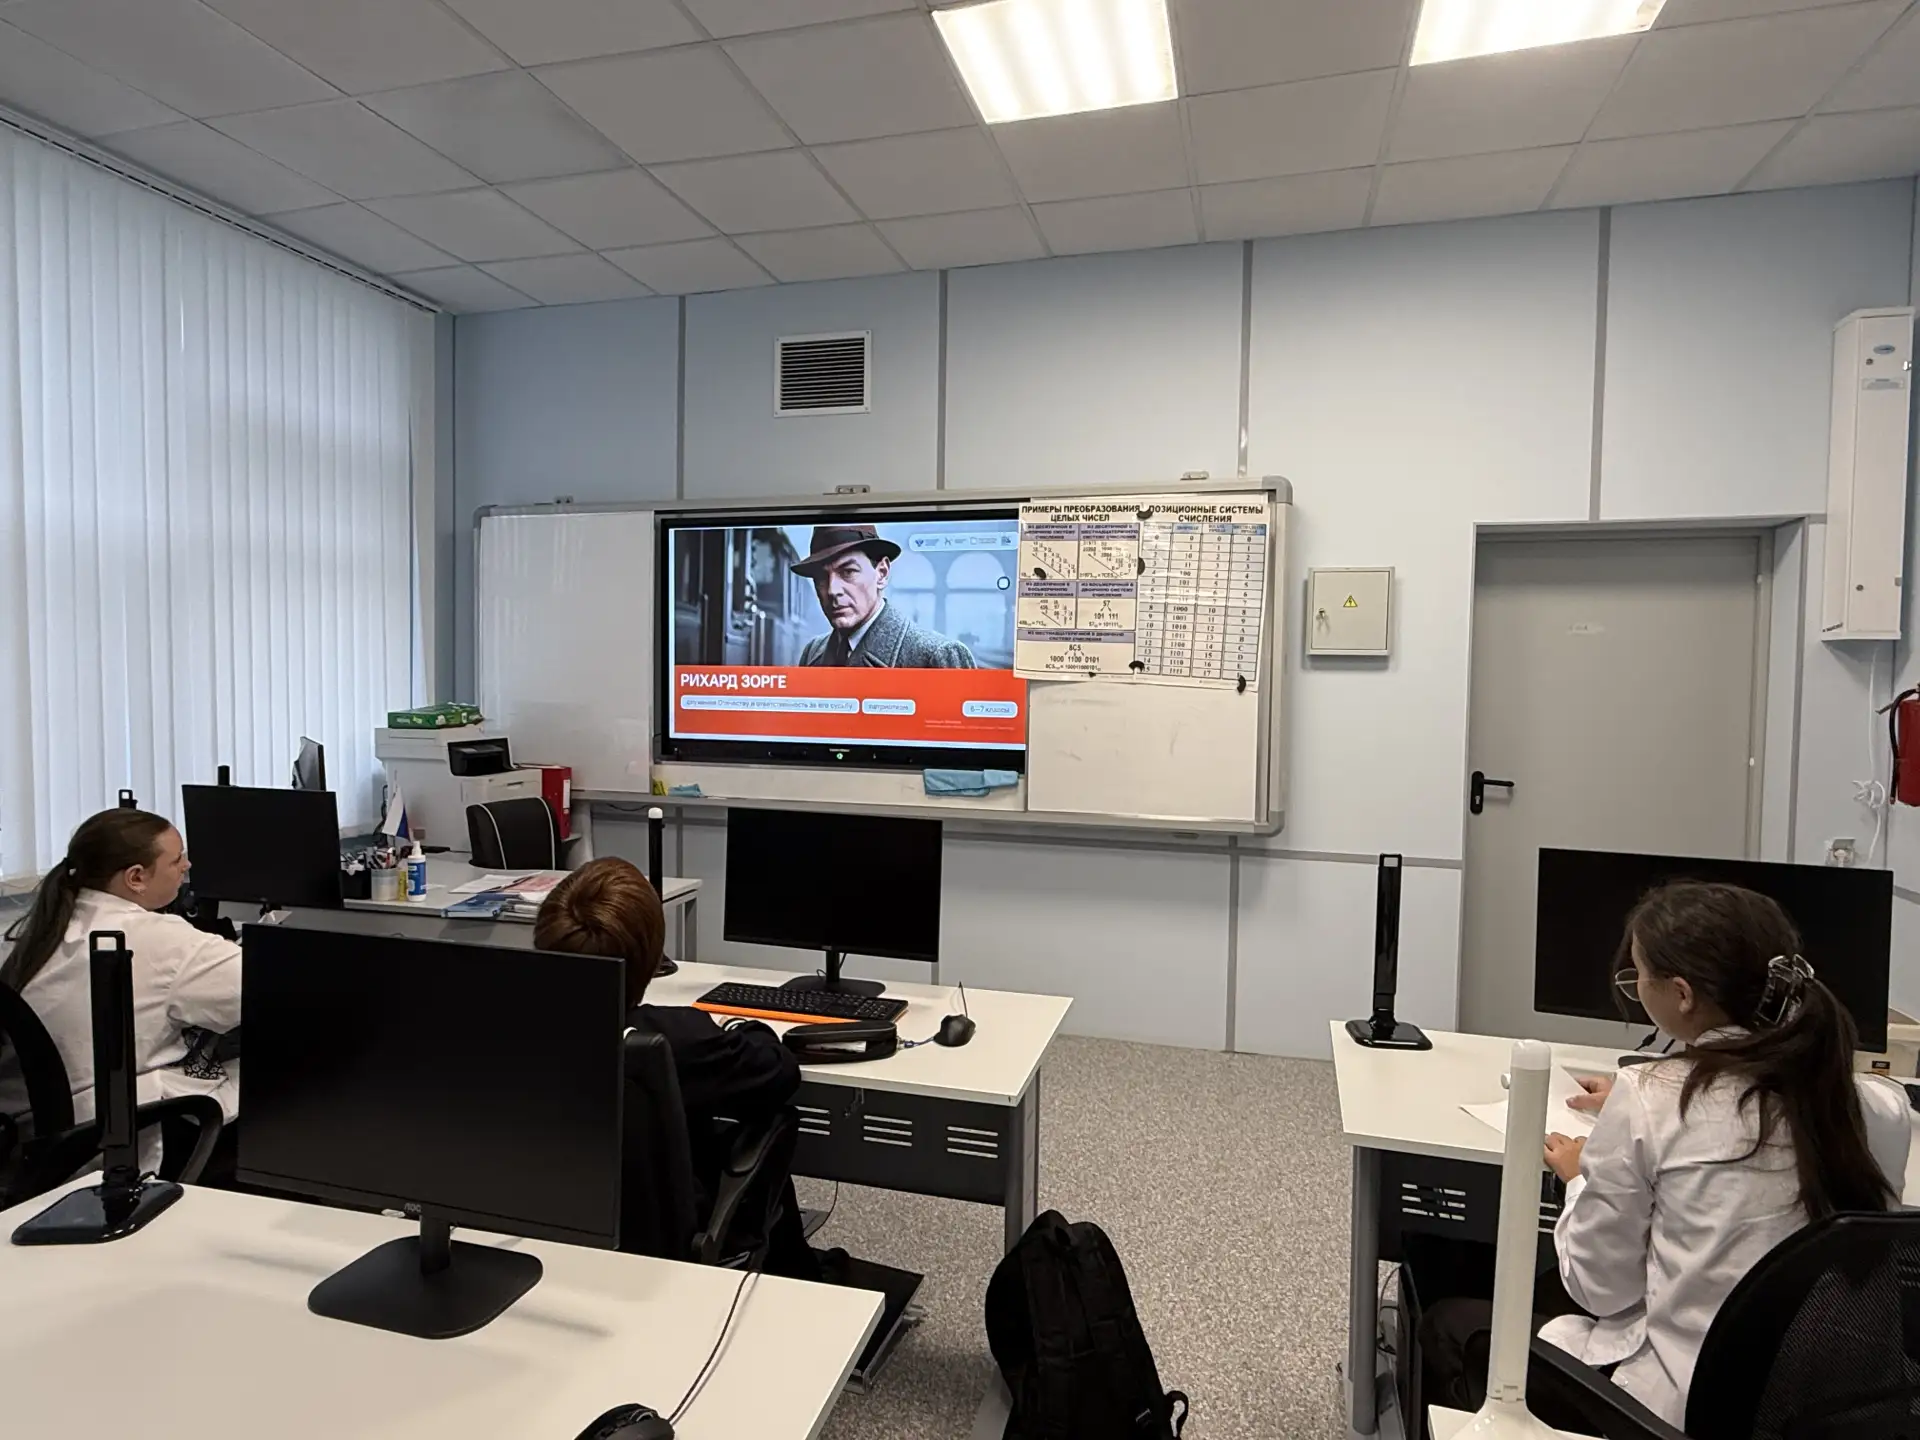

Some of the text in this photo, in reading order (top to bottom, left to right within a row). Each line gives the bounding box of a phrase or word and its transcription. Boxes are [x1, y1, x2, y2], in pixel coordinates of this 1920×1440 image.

[1021, 505, 1140, 513] ПРИМЕРЫ ПРЕОБРАЗОВАНИЯ
[1148, 505, 1264, 514] ПОЗИЦИОННЫЕ СИСТЕМЫ
[1050, 514, 1080, 522] ЦЕЛЫХ
[1178, 514, 1232, 522] СЧИСЛЕНИЯ
[680, 674, 787, 690] РИХАРД ЗОРГЕ
